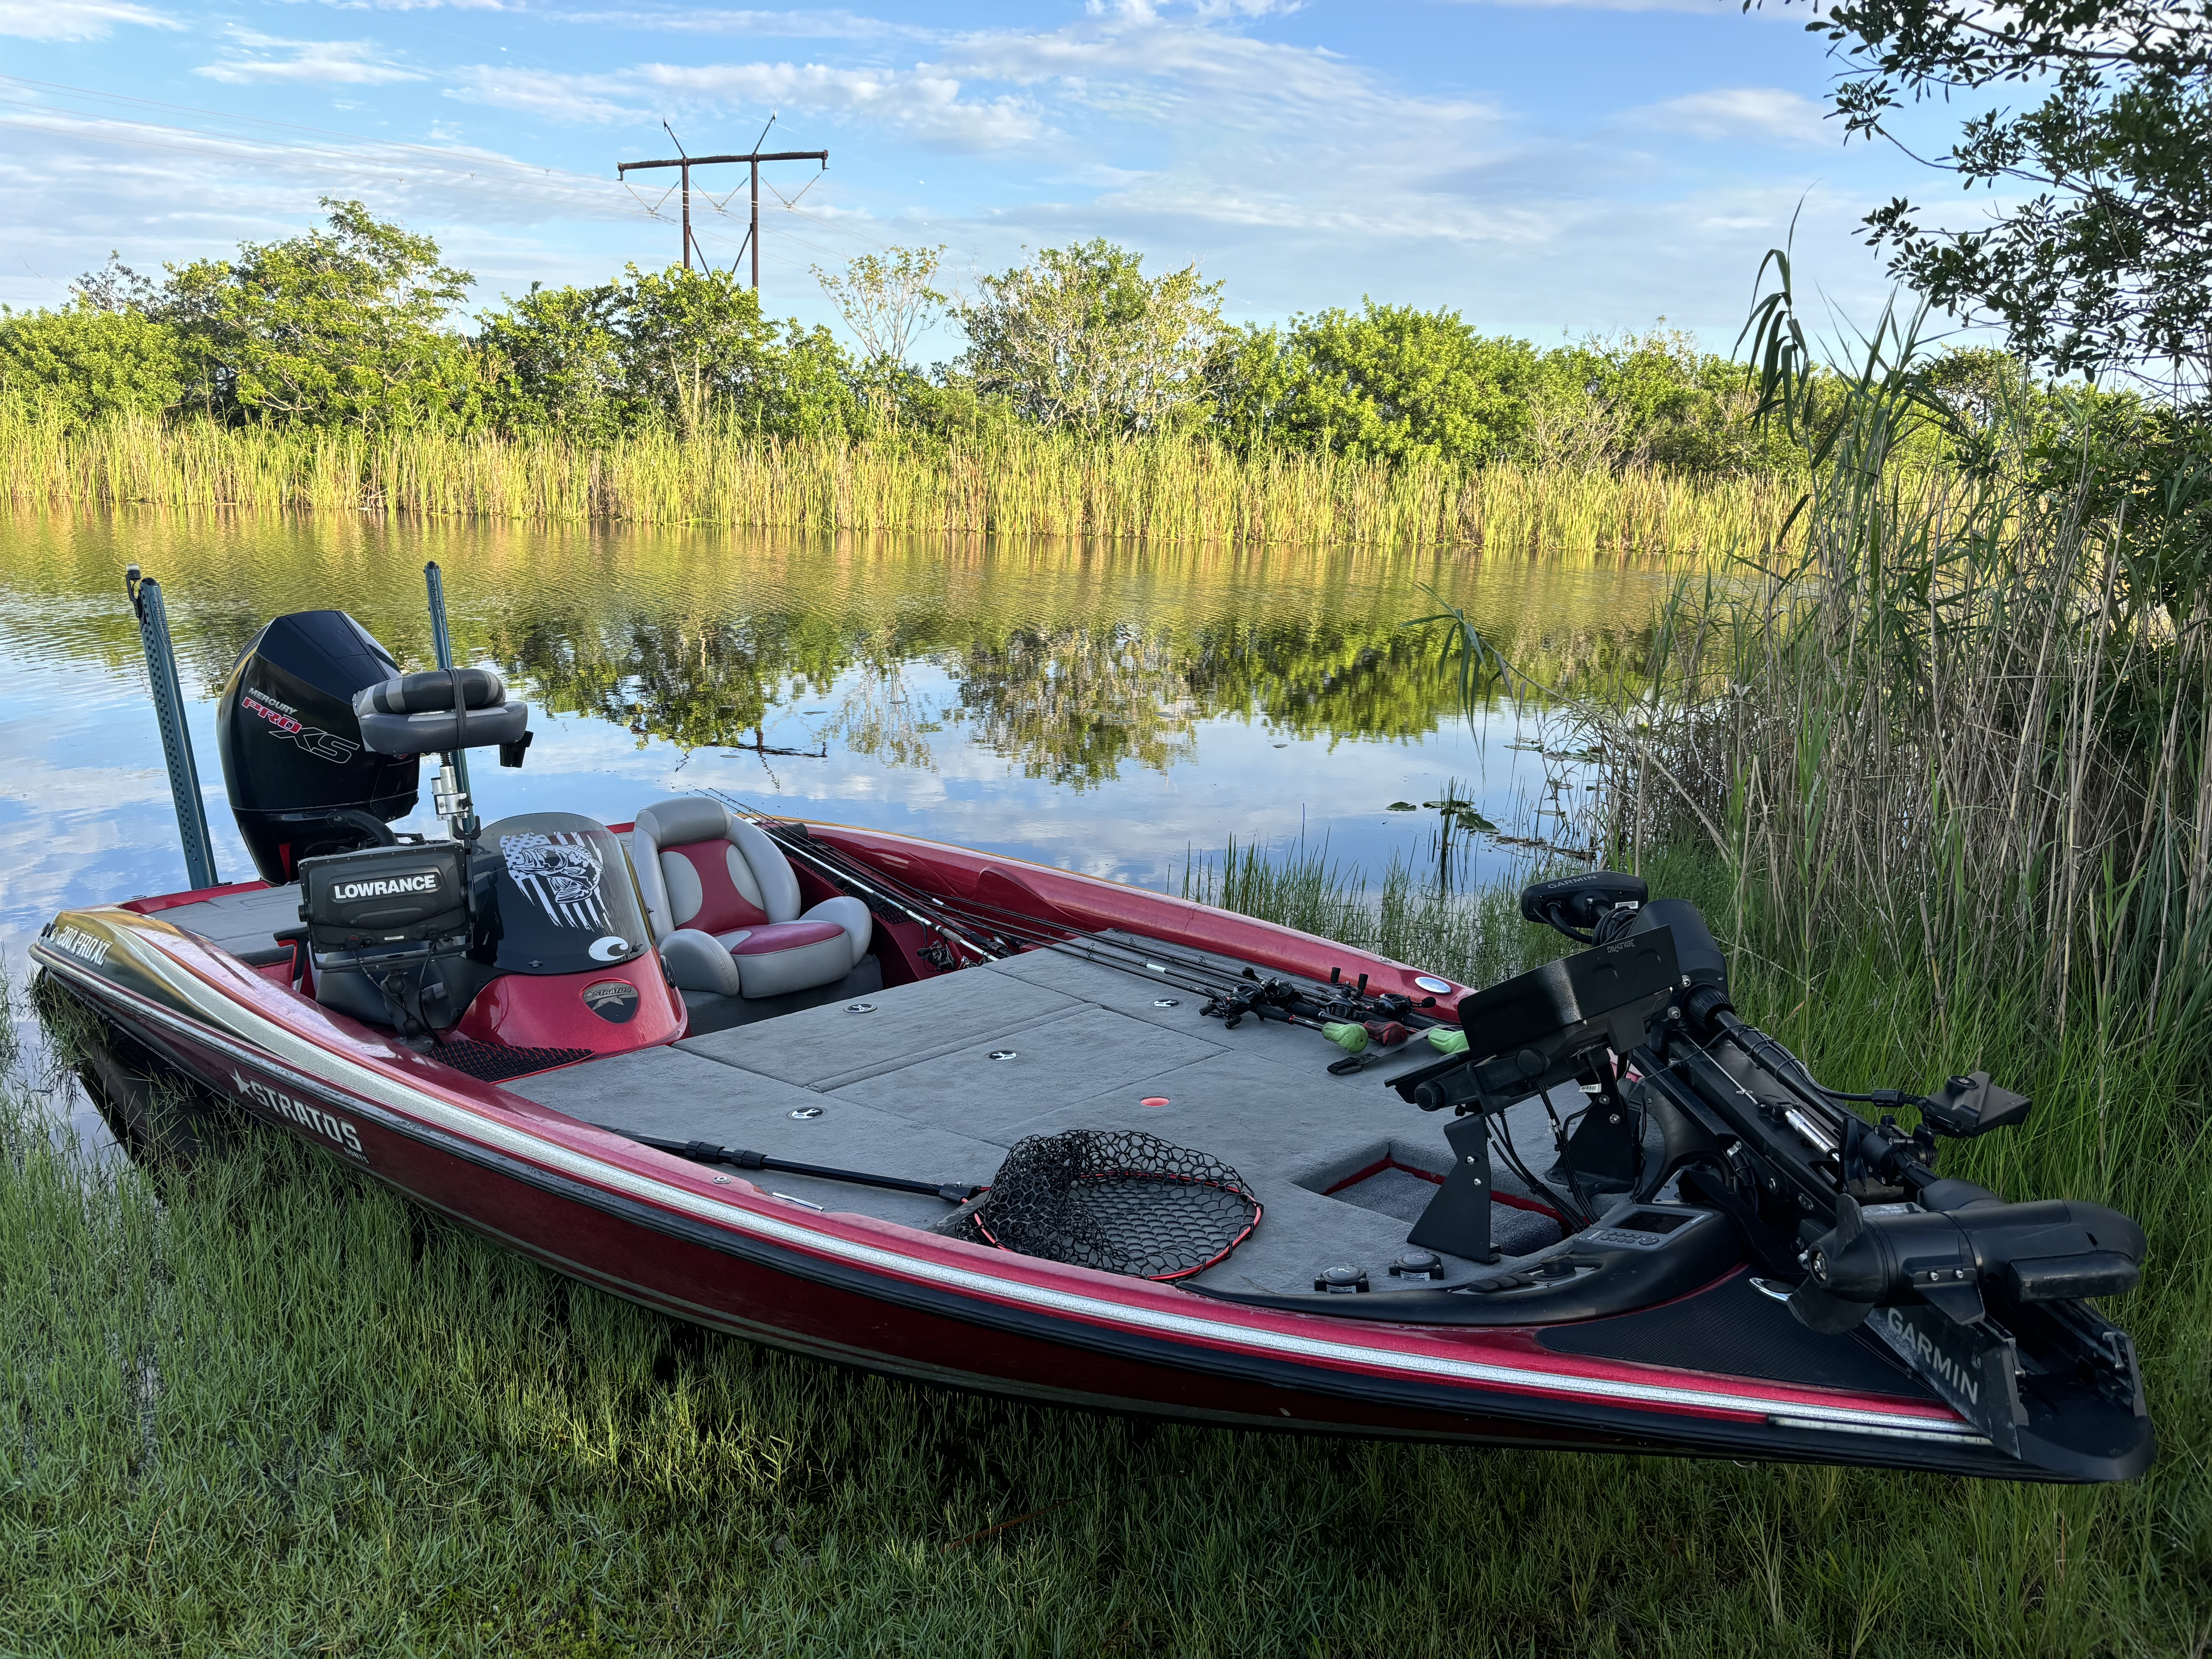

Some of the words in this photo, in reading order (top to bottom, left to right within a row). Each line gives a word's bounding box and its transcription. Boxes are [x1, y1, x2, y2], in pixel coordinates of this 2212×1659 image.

[248, 687, 298, 715] MERCURY
[334, 874, 436, 899] LOWRANCE
[1547, 875, 1597, 888] GARMIN
[56, 925, 78, 950] 200
[593, 986, 632, 997] STRATOS
[250, 1080, 362, 1152] STRATOS
[343, 1147, 369, 1164] BOATS
[1888, 1307, 1978, 1405] GARMIN
